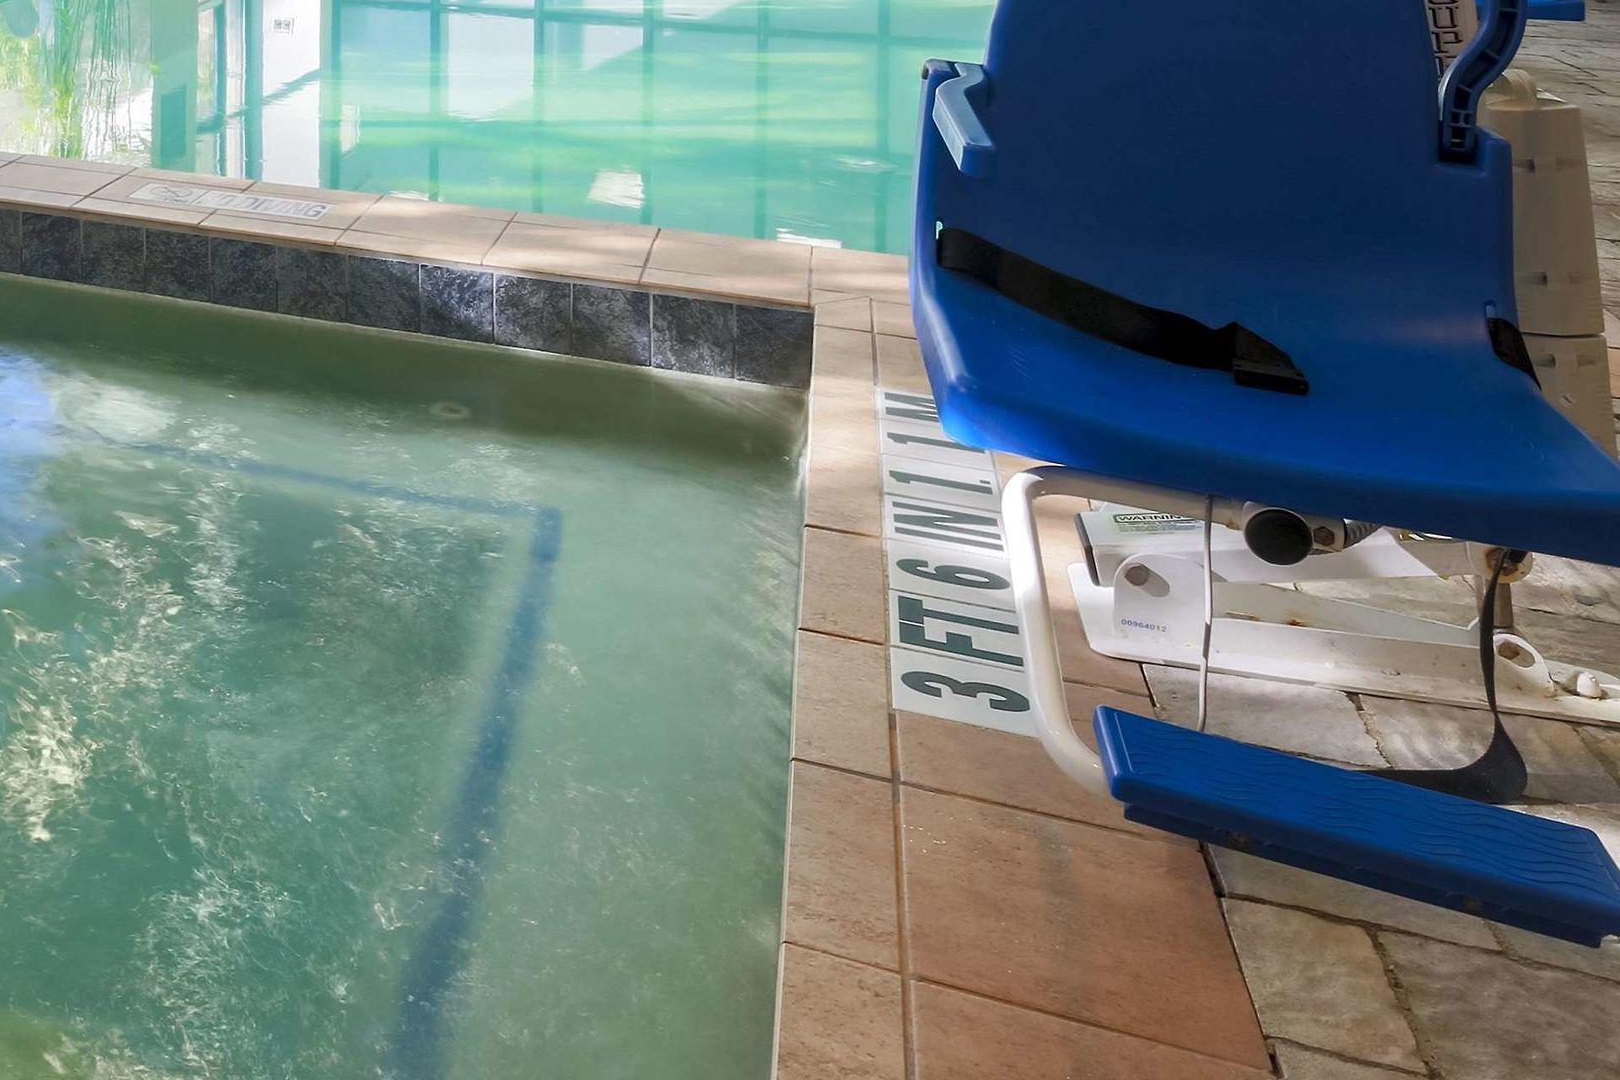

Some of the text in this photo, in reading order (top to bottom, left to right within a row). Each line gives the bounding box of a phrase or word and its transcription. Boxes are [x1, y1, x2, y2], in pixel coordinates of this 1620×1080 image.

[892, 500, 1005, 552] IN
[896, 558, 1011, 591] 6
[898, 595, 1024, 668] FT
[900, 670, 1030, 713] 3
